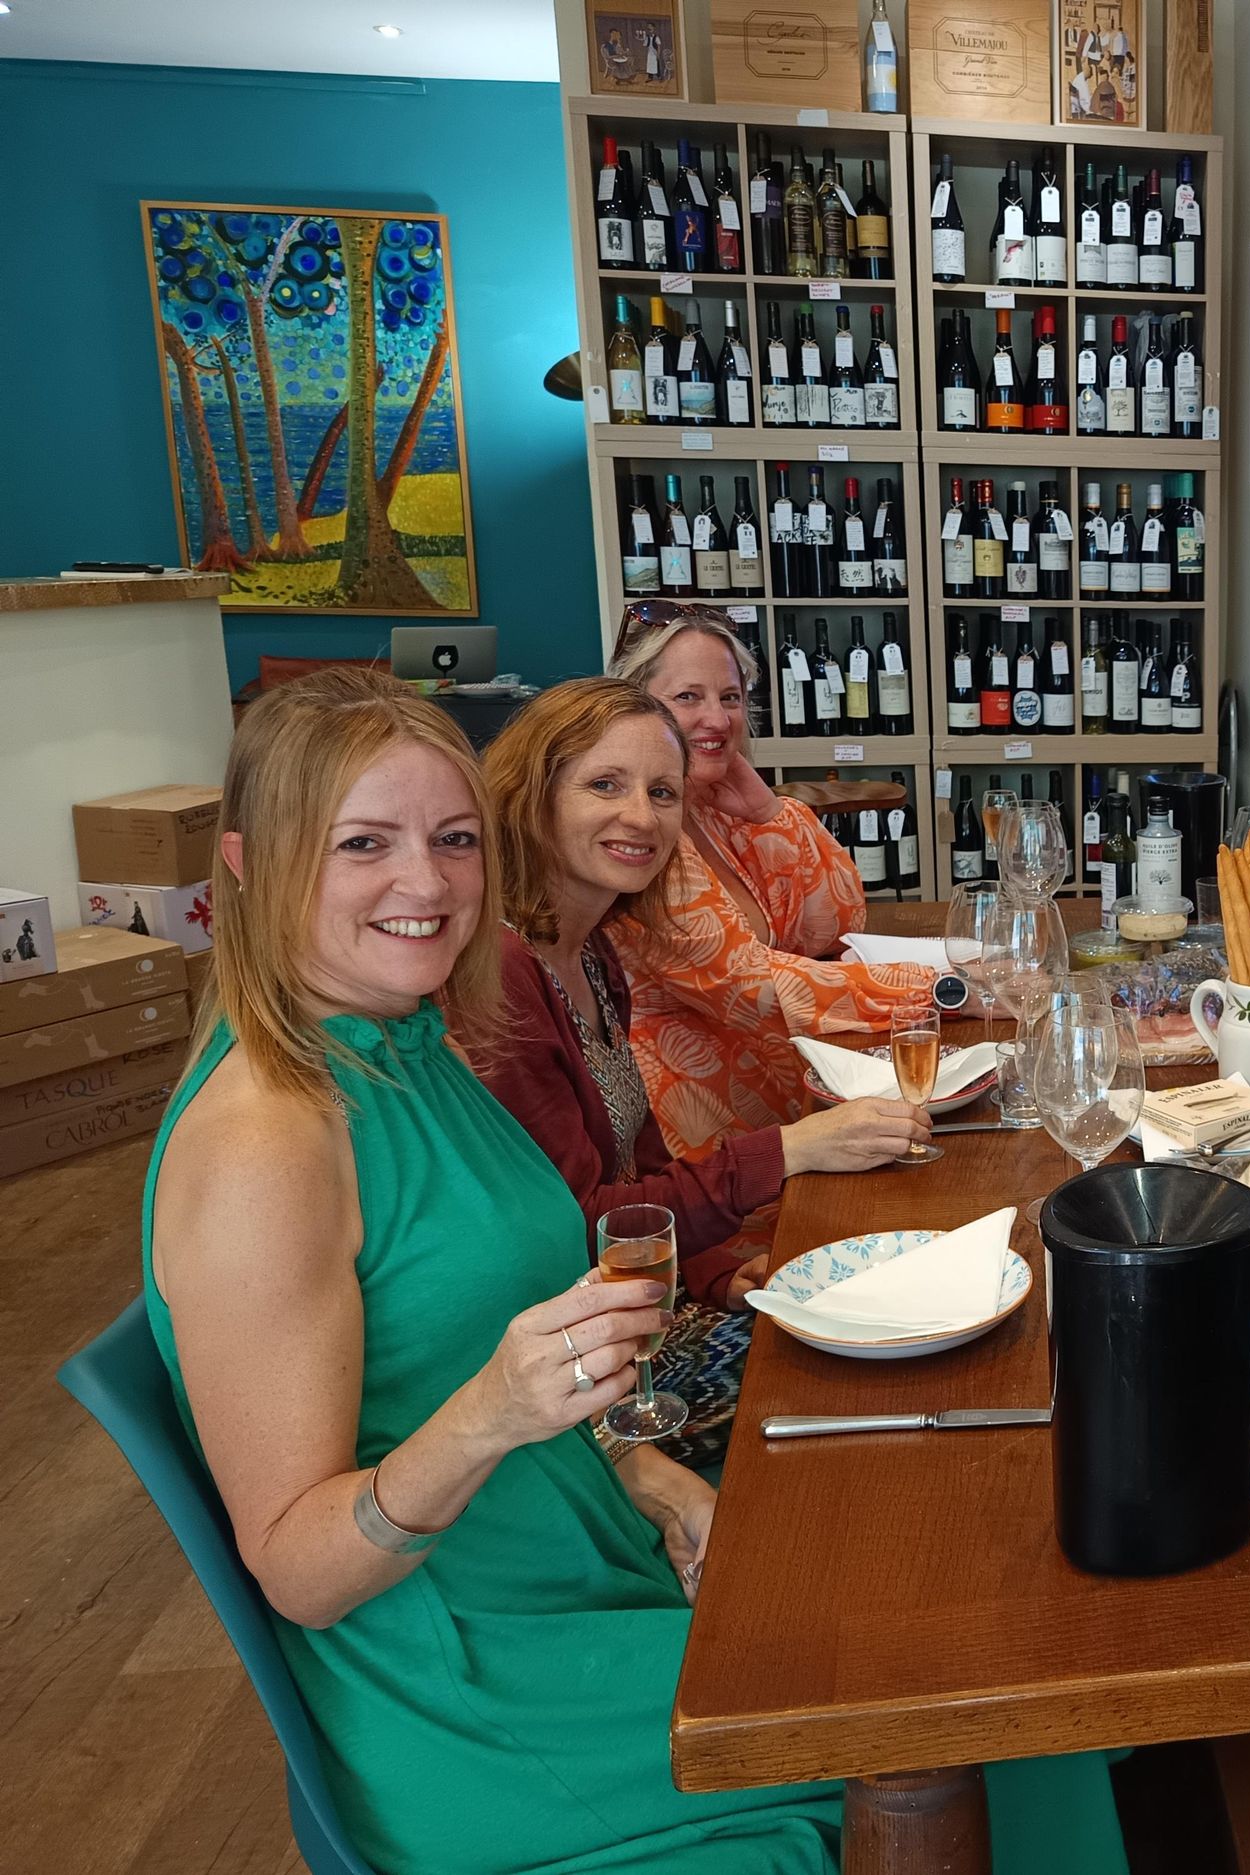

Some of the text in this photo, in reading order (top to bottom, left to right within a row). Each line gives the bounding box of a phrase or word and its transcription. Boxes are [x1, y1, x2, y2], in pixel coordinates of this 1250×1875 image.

[945, 30, 1008, 51] VILLEMAJOU
[15, 1069, 120, 1110] TASQUE
[1158, 1083, 1224, 1104] ESPINALER
[46, 1110, 133, 1149] CABROL
